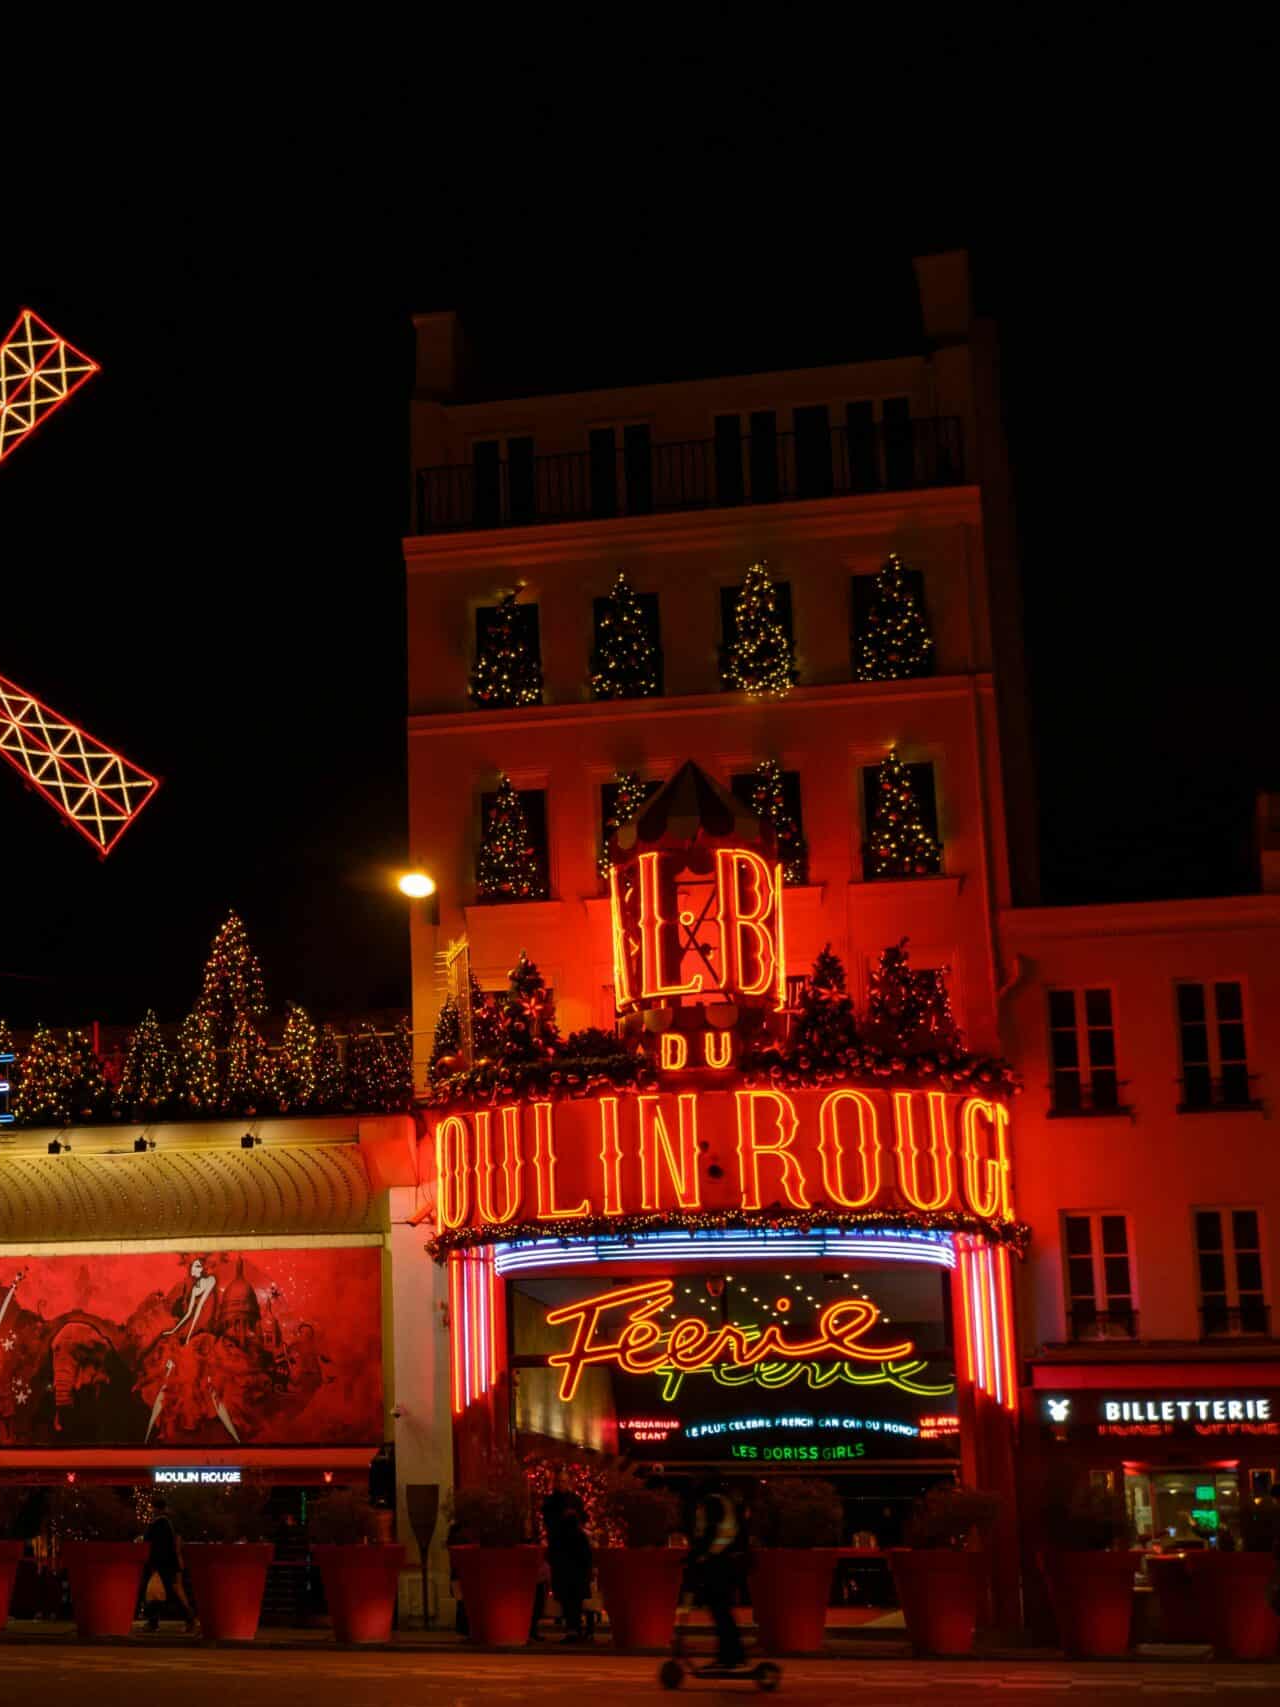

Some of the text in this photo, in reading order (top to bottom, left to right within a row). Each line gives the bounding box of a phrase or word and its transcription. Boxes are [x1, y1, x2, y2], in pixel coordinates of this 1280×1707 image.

[661, 1032, 733, 1070] DU
[436, 1093, 701, 1235] OULIN
[546, 1279, 914, 1401] Féerie
[1105, 1399, 1272, 1422] BILLETTERIE
[700, 1422, 728, 1435] PLUS
[817, 1417, 840, 1428] CAN
[731, 1443, 865, 1460] LES DORISS GIRLS
[155, 1470, 242, 1483] MOULIN ROUGE
